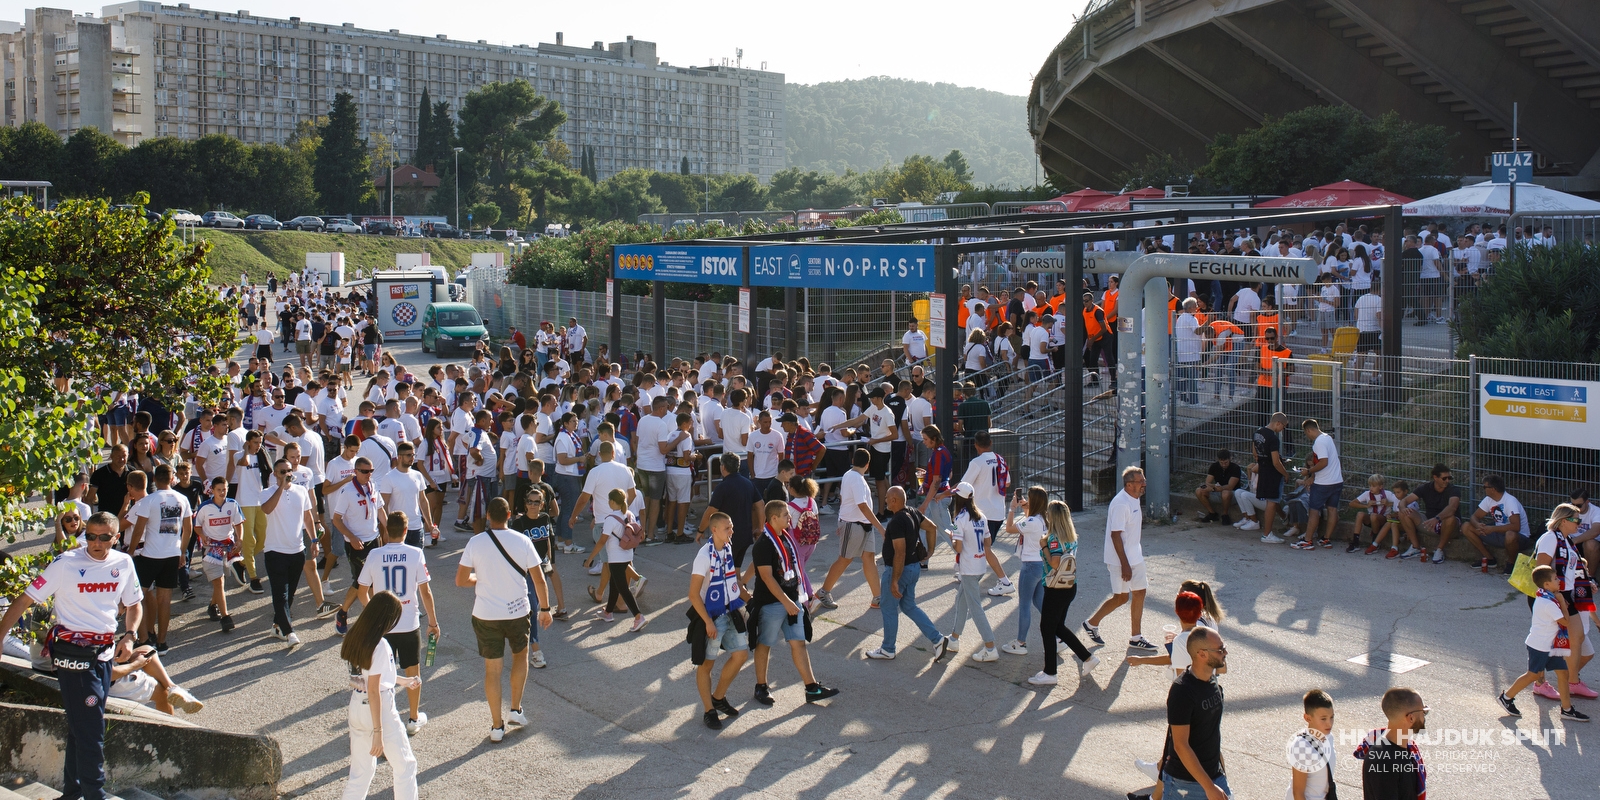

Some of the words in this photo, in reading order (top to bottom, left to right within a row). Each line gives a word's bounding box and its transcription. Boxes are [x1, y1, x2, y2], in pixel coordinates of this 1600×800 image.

[1493, 153, 1532, 167] ULAZ
[1508, 168, 1517, 182] 5
[701, 256, 737, 276] ISTOK
[754, 257, 783, 275] EAST
[1020, 257, 1063, 269] OPRSTU
[1189, 261, 1300, 279] EFGHIJKLMN
[391, 286, 403, 294] FAST
[404, 285, 417, 293] SHOP
[1496, 384, 1527, 395] ISTOK
[1534, 388, 1555, 397] EAST
[1505, 404, 1526, 414] JUG
[1534, 407, 1564, 417] SOUTH
[382, 553, 407, 563] LIVAJA
[77, 582, 119, 593] TOMMY
[382, 565, 407, 597] 10
[53, 657, 90, 670] adidas
